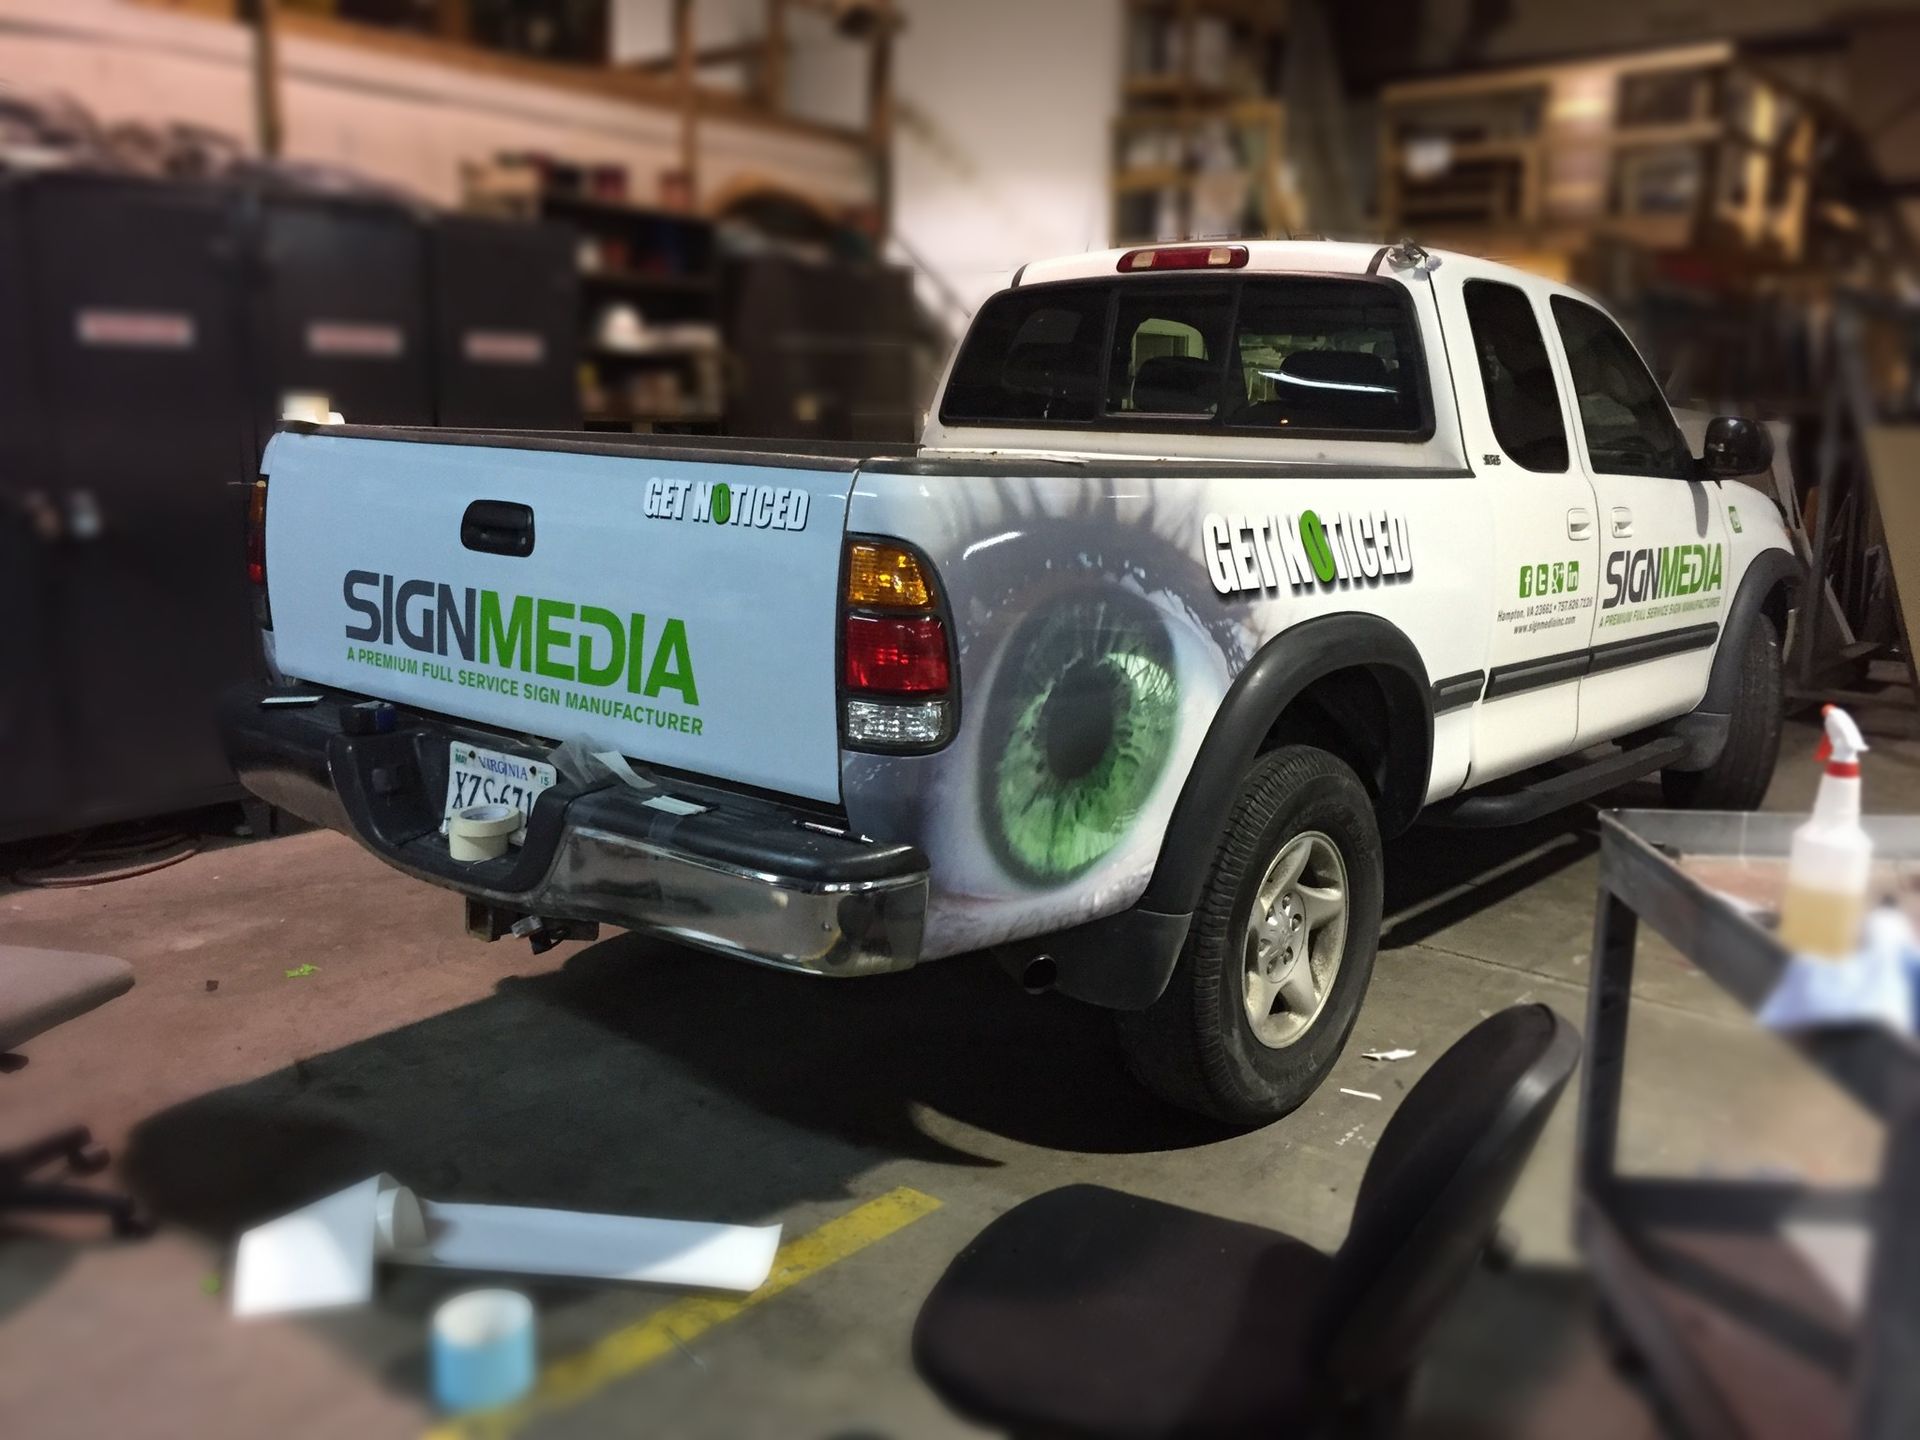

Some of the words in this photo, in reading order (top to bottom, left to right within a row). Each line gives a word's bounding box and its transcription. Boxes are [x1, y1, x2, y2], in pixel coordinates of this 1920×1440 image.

[643, 477, 692, 521] GET
[692, 481, 811, 532] NOTICED
[1202, 512, 1278, 596] GET
[1276, 510, 1413, 589] NOTICED
[1602, 542, 1722, 609] SIGNMEDIA
[343, 569, 699, 706] SIGNMEDIA
[1526, 606, 1534, 617] VA
[347, 646, 355, 661] A
[358, 648, 418, 675] PREMIUM
[422, 662, 454, 683] FULL
[458, 669, 519, 696] SERVICE
[523, 683, 560, 706] SIGN
[565, 691, 703, 736] MANUFACTURER
[478, 755, 529, 781] VIRGINIA
[540, 775, 549, 786] 15
